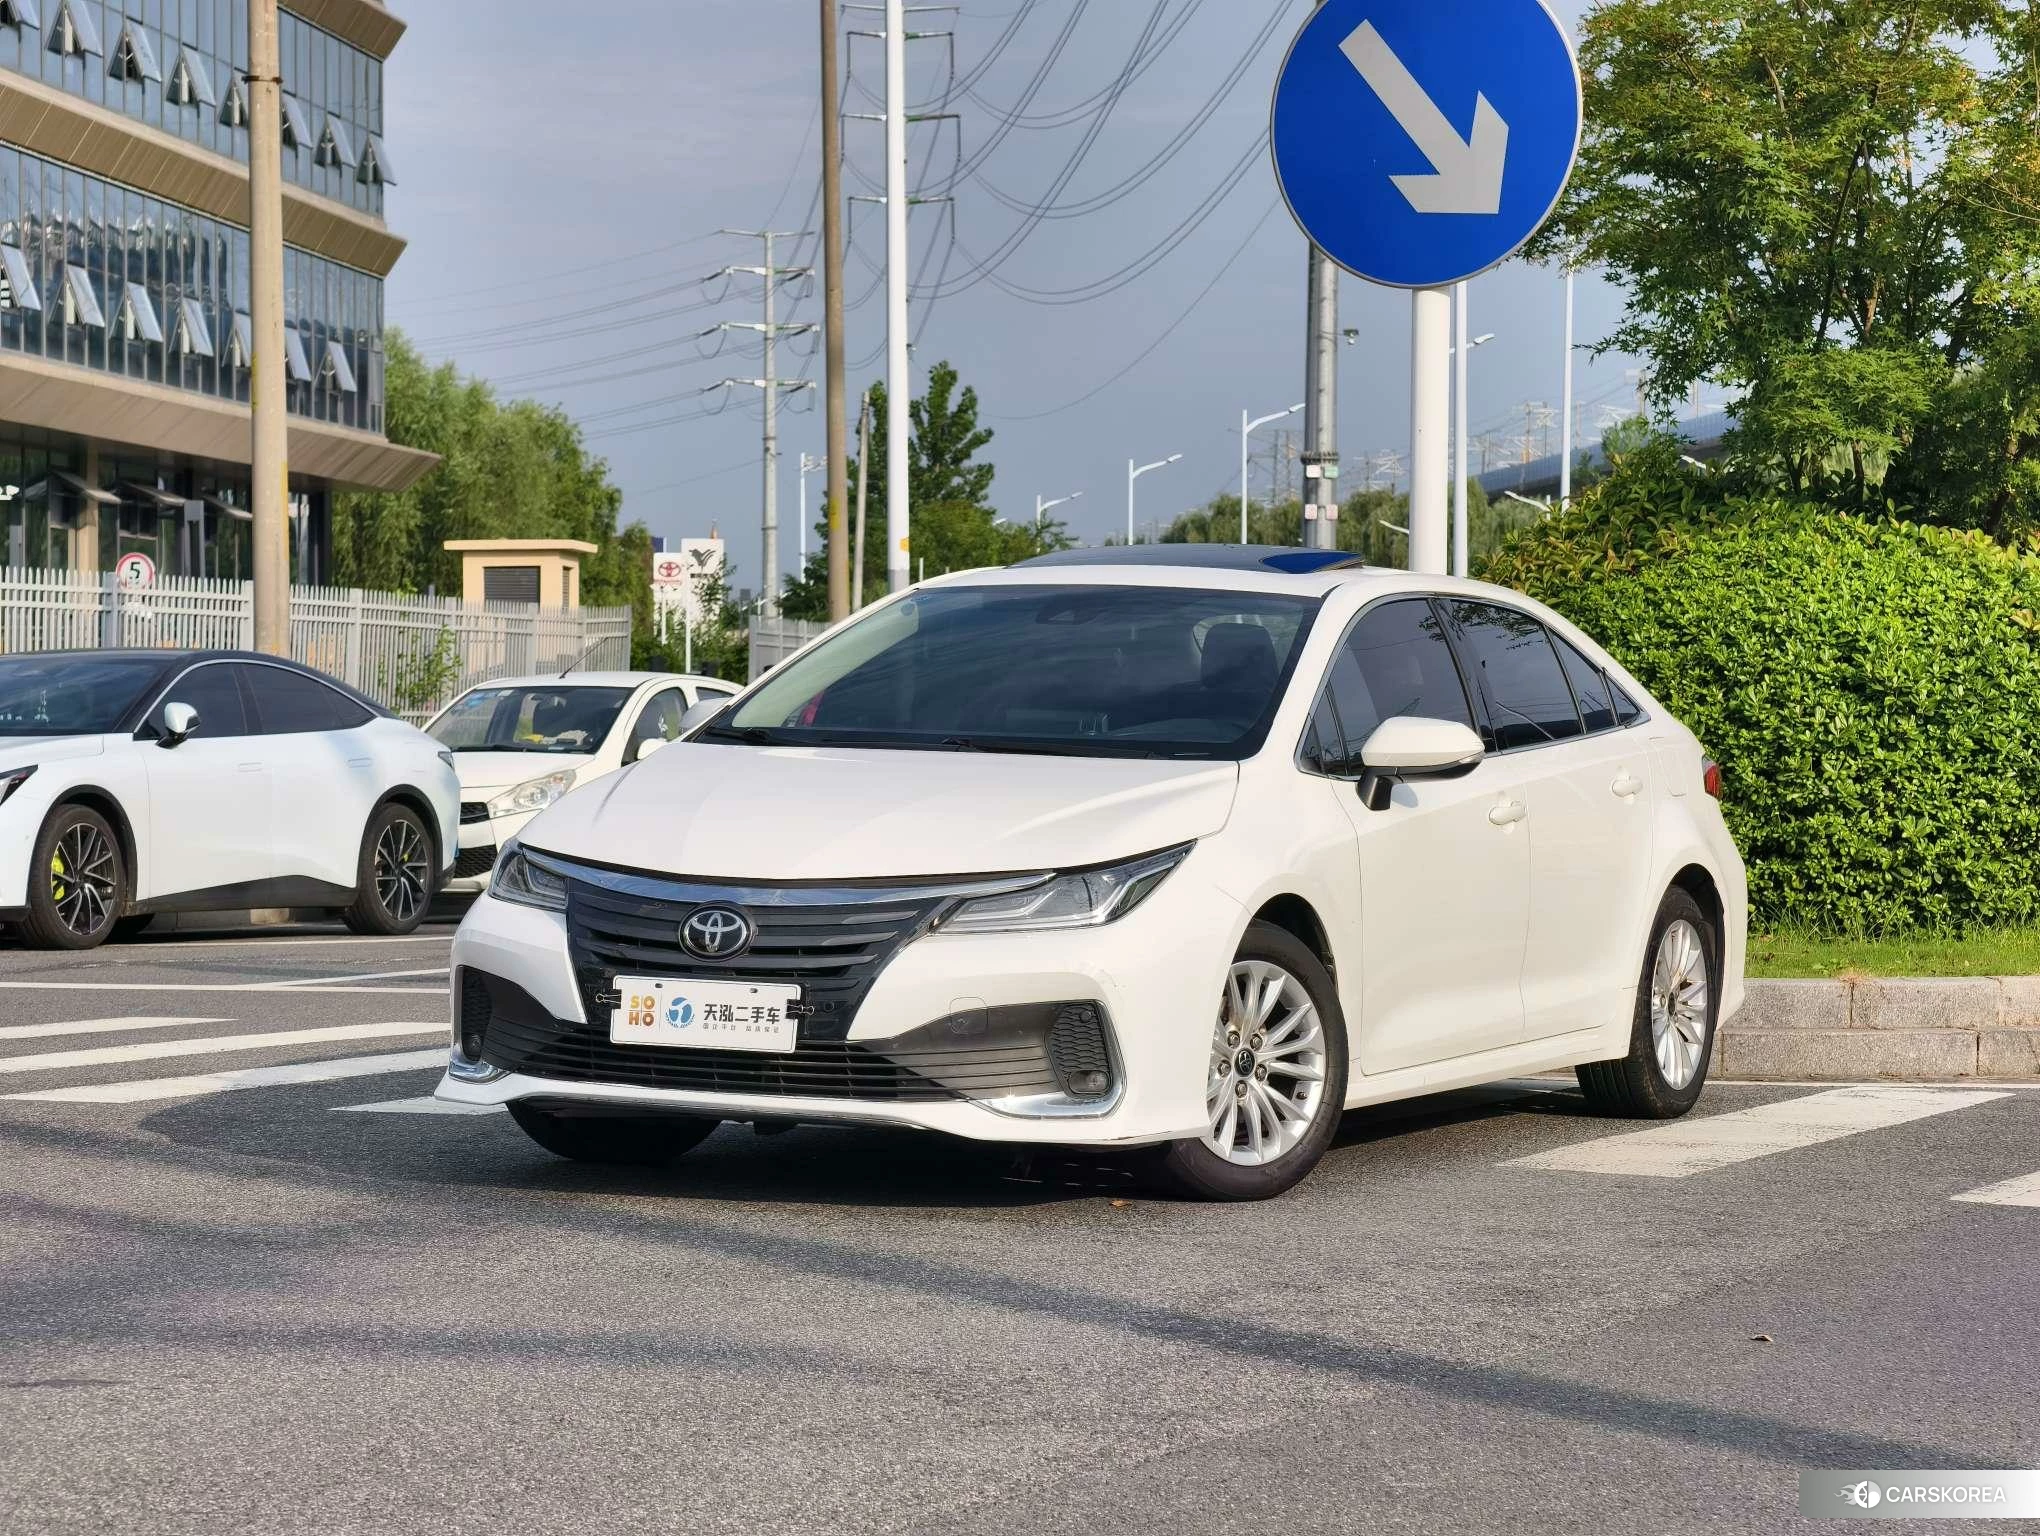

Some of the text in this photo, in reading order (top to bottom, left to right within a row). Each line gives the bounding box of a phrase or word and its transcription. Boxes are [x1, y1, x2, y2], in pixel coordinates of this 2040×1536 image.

[129, 562, 141, 581] 5
[703, 1003, 781, 1024] 天泓二手车
